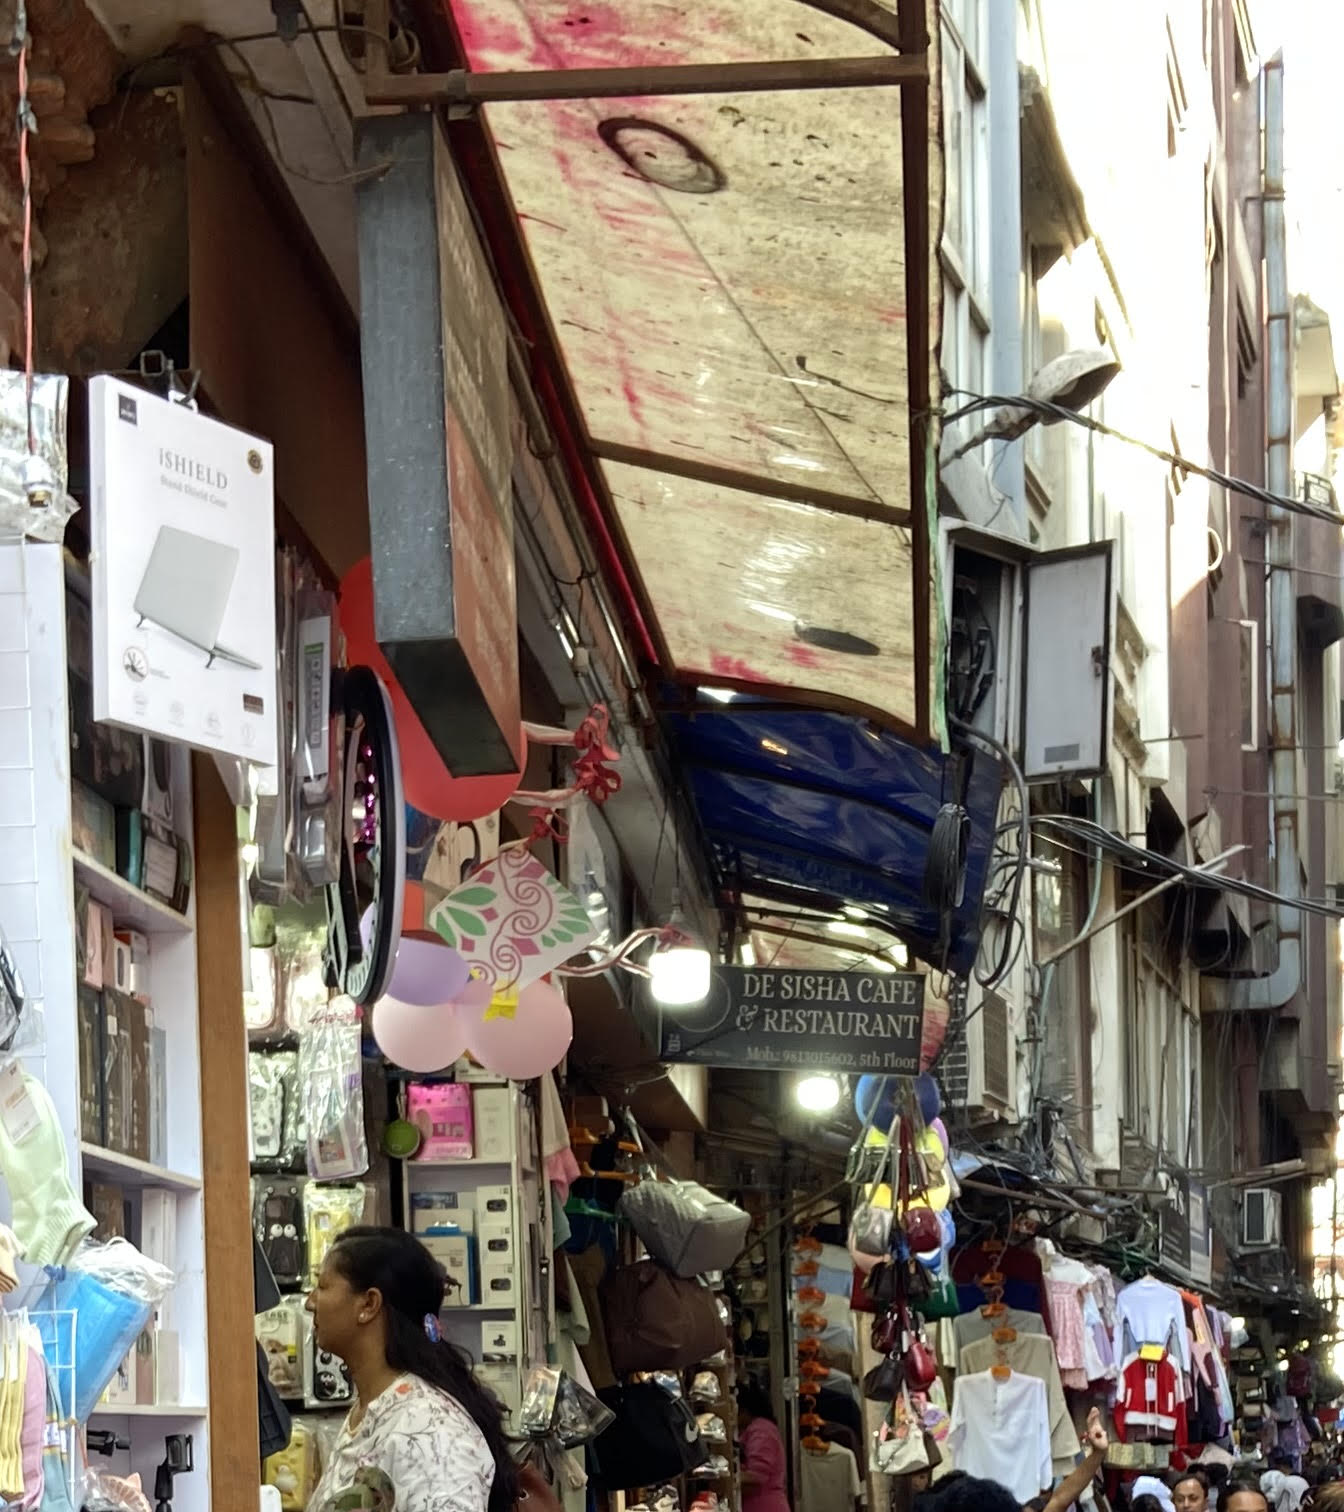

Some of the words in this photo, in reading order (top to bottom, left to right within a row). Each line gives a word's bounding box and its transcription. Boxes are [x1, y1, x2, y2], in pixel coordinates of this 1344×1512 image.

[743, 973, 775, 998] DE
[780, 975, 850, 1002] SISHA
[857, 978, 917, 1005] CAFE
[735, 1004, 759, 1031] &
[763, 1008, 919, 1040] RESTAURANT
[859, 1051, 881, 1067] 5th
[884, 1052, 918, 1069] Floor
